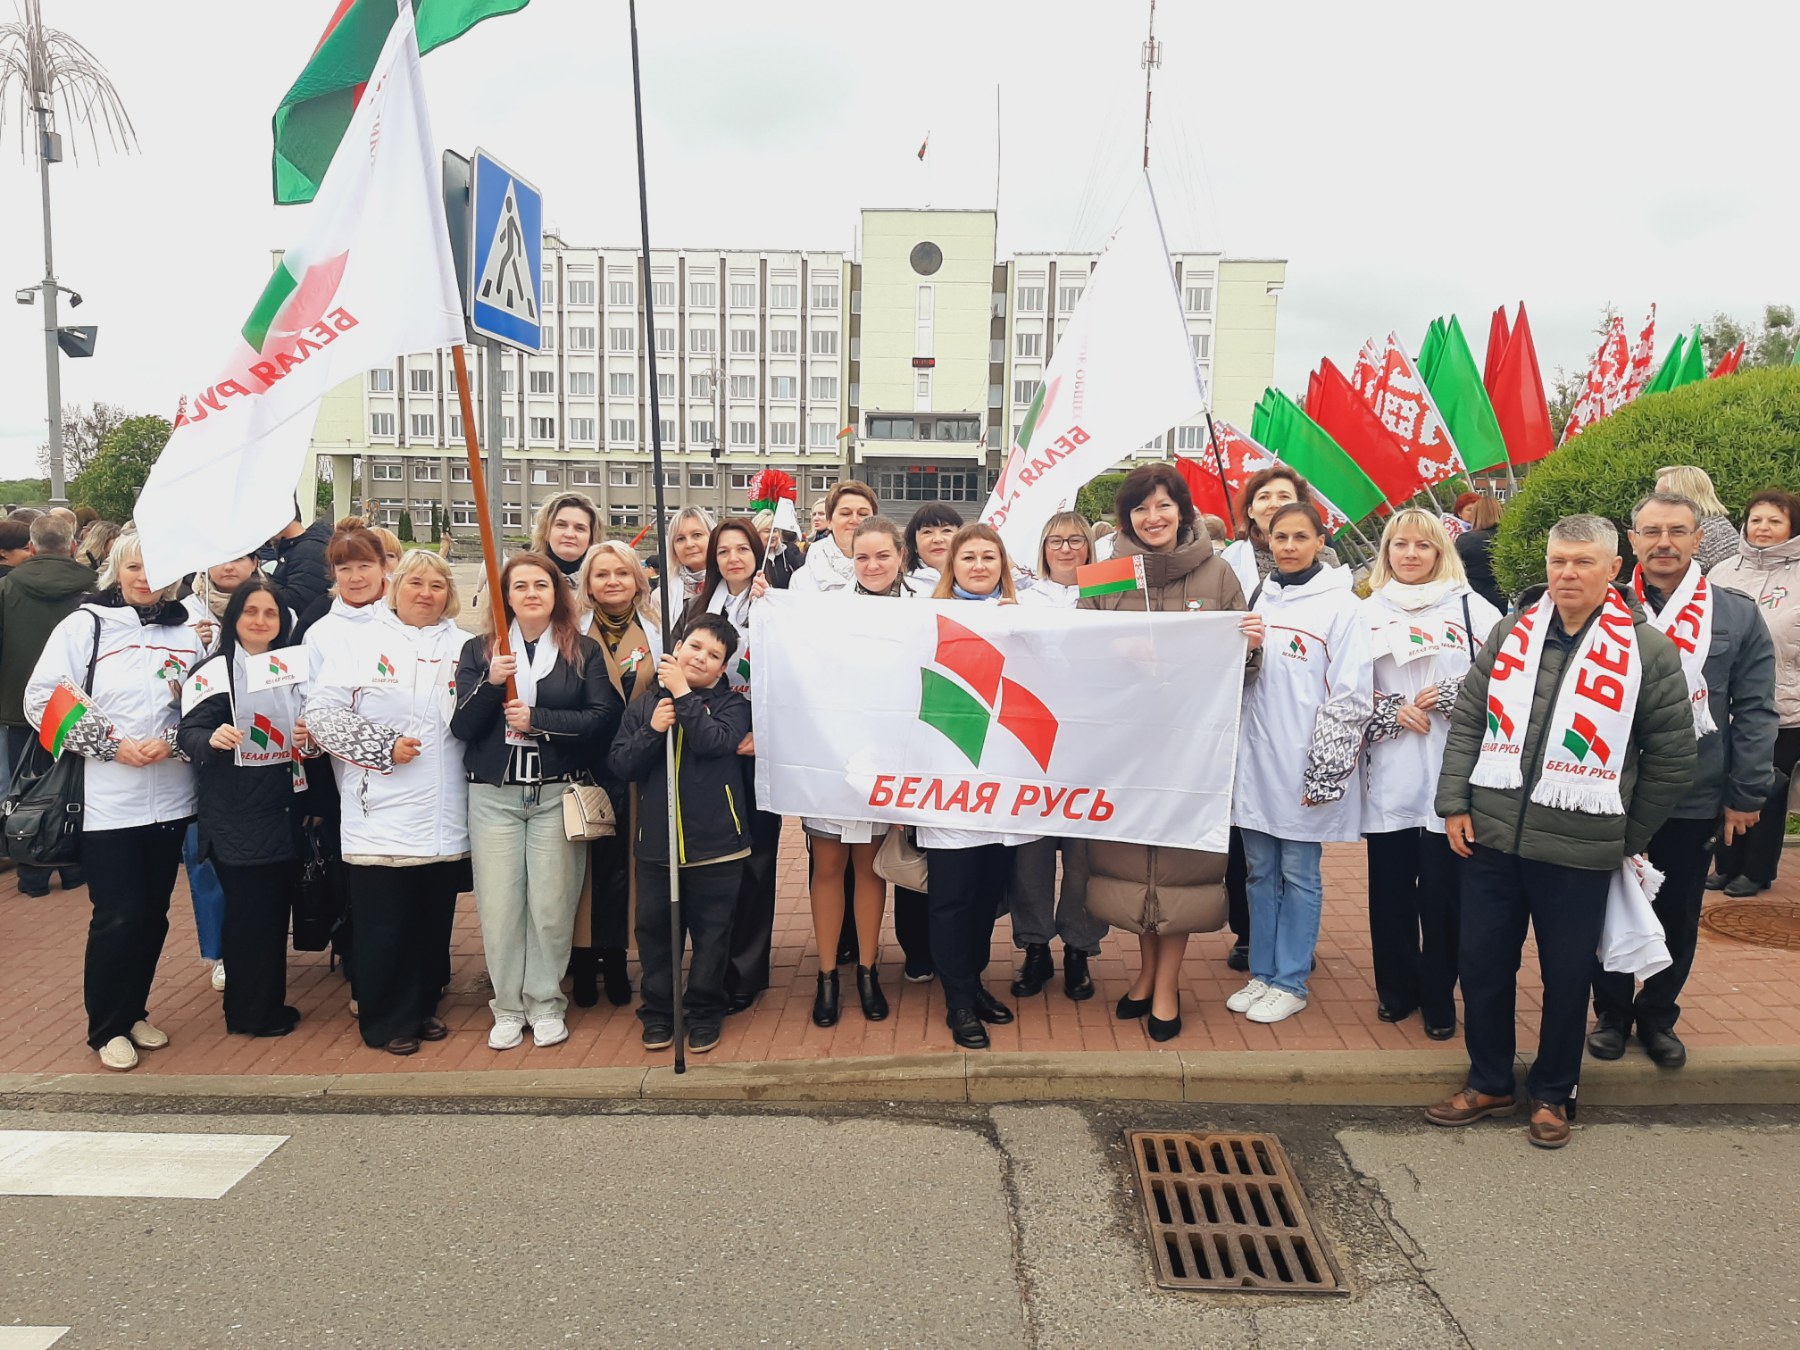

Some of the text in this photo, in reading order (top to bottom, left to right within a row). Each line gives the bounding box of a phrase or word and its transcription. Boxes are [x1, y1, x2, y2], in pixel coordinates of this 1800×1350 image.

[241, 751, 270, 761] БЕЛАЯ
[1499, 743, 1520, 755] РУСЬ
[1545, 760, 1617, 781] БЕЛАЯ РУСЬ
[868, 775, 1115, 822] БЕЛАЯ РУСЬ
